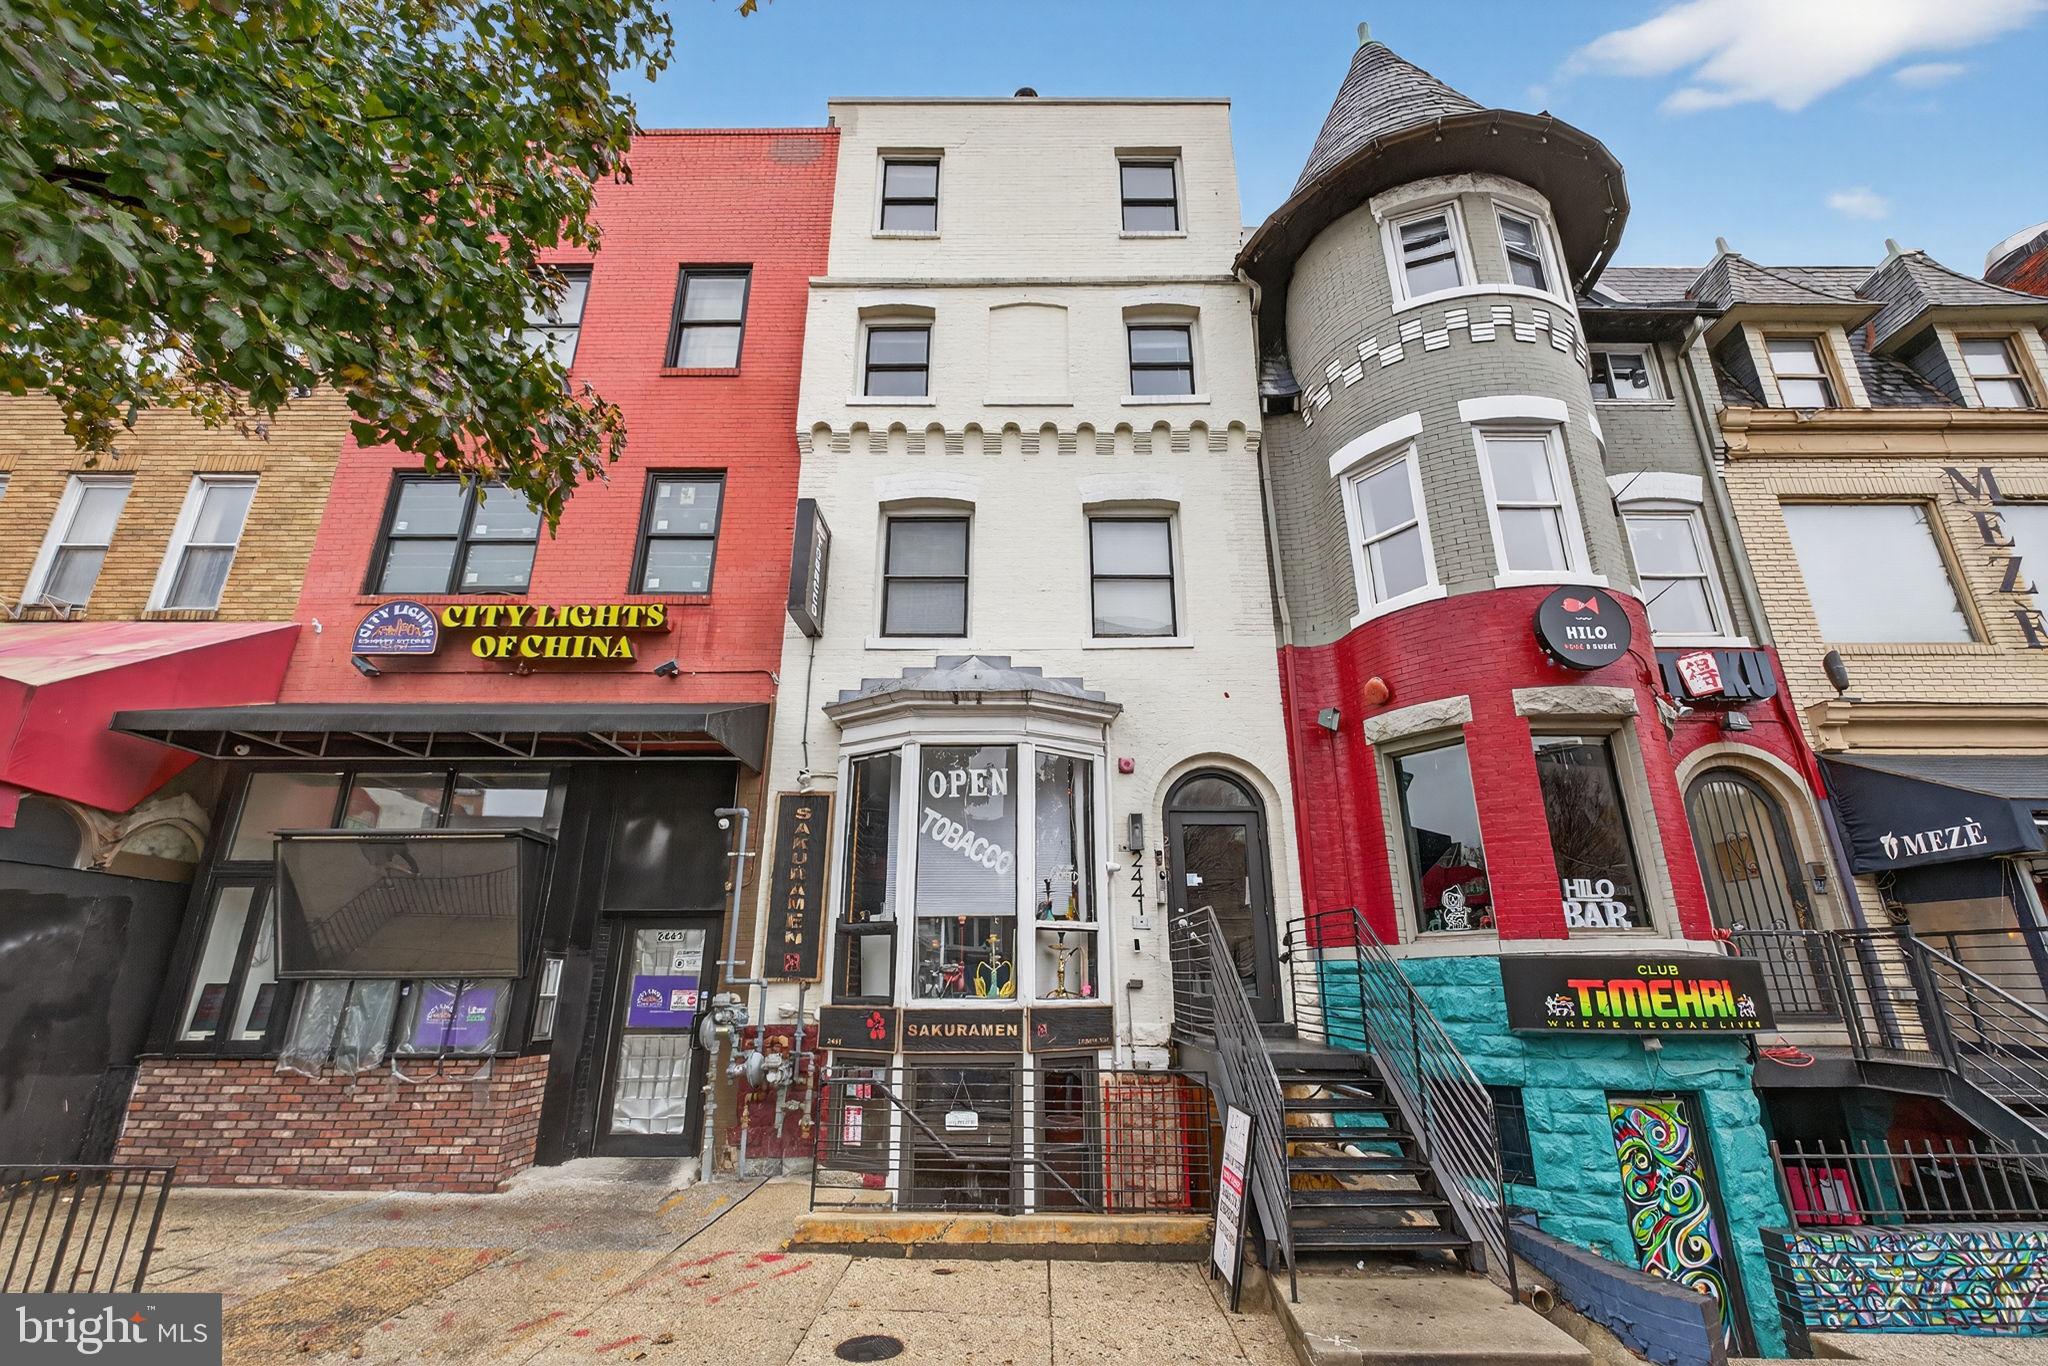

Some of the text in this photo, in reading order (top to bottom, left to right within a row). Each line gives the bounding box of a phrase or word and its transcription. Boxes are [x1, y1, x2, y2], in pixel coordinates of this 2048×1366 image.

[440, 603, 665, 628] CITY LIGHTS
[1565, 625, 1608, 640] HILO
[471, 635, 633, 658] OF CHINA
[928, 767, 1009, 799] OPEN
[920, 806, 1014, 875] TOBACCO
[1899, 816, 1988, 857] MEZÈ
[784, 807, 813, 945] SAKURAMEN
[1130, 849, 1145, 916] 2441
[1563, 878, 1615, 899] HILO
[1562, 901, 1632, 930] BAR
[1637, 965, 1679, 976] CLUB
[907, 1024, 1019, 1037] SAKURAMEN
[1547, 1019, 1761, 1030] WHERE REGGAE LIVES
